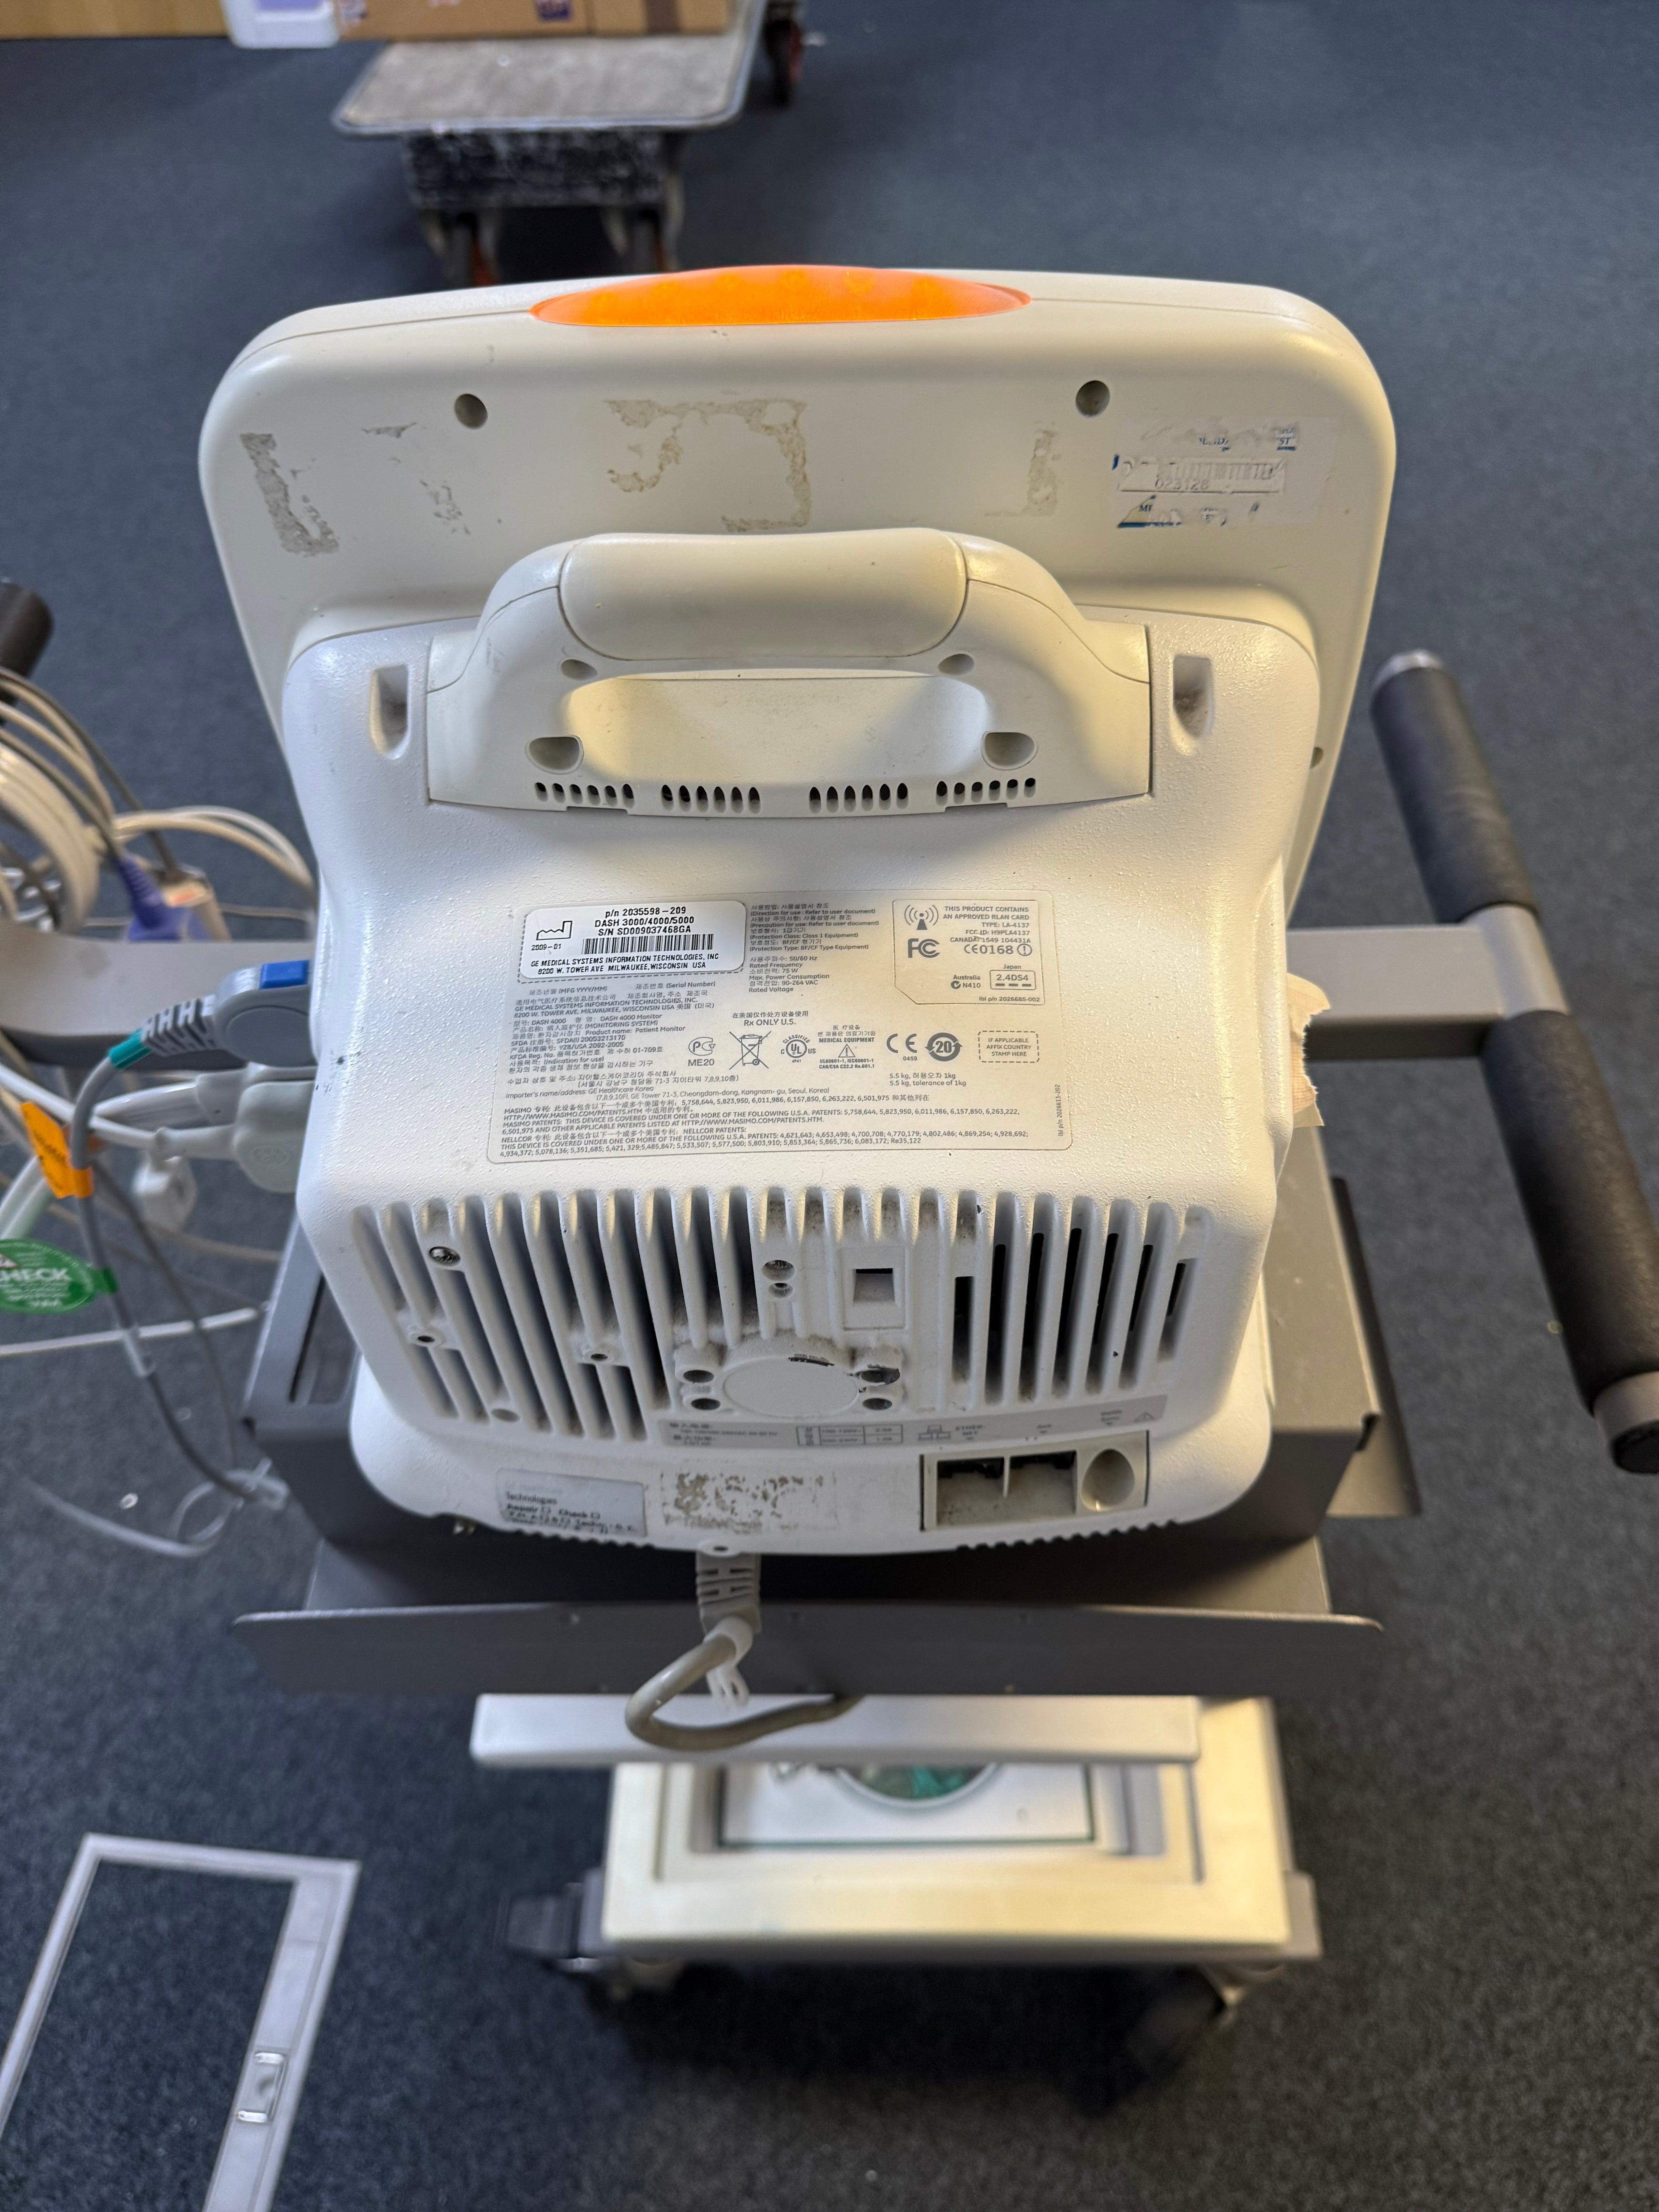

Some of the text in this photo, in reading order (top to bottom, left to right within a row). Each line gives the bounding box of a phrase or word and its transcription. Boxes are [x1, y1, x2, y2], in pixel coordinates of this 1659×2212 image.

[605, 909, 618, 918] p/n
[622, 916, 693, 926] 3000/4000/5000
[617, 925, 691, 934] SD009037468GA
[654, 953, 704, 962] TECHNOLOGIES,
[783, 1034, 810, 1044] CLASSIFIED
[791, 1043, 802, 1054] UL
[936, 1041, 952, 1053] 20
[680, 1090, 740, 1098] Cheongdam-dong,
